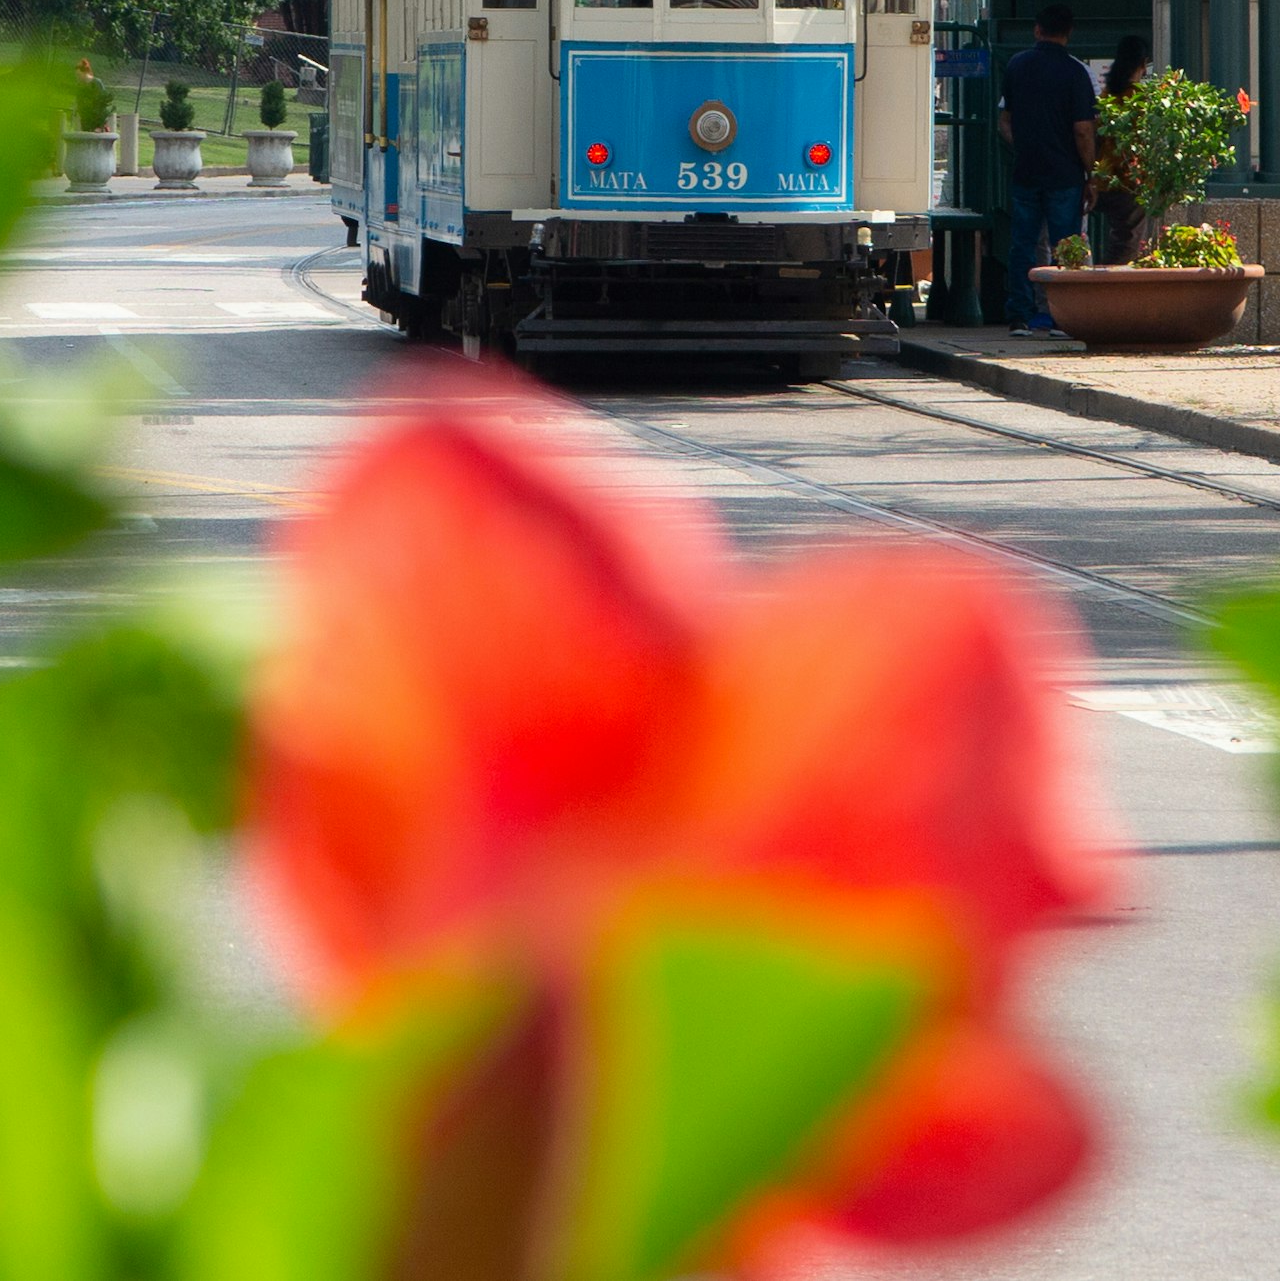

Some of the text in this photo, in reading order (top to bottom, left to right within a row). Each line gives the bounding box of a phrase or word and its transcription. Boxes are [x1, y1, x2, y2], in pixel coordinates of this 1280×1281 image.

[589, 171, 648, 190] MATA
[677, 162, 748, 190] 539
[777, 173, 829, 191] MATA
